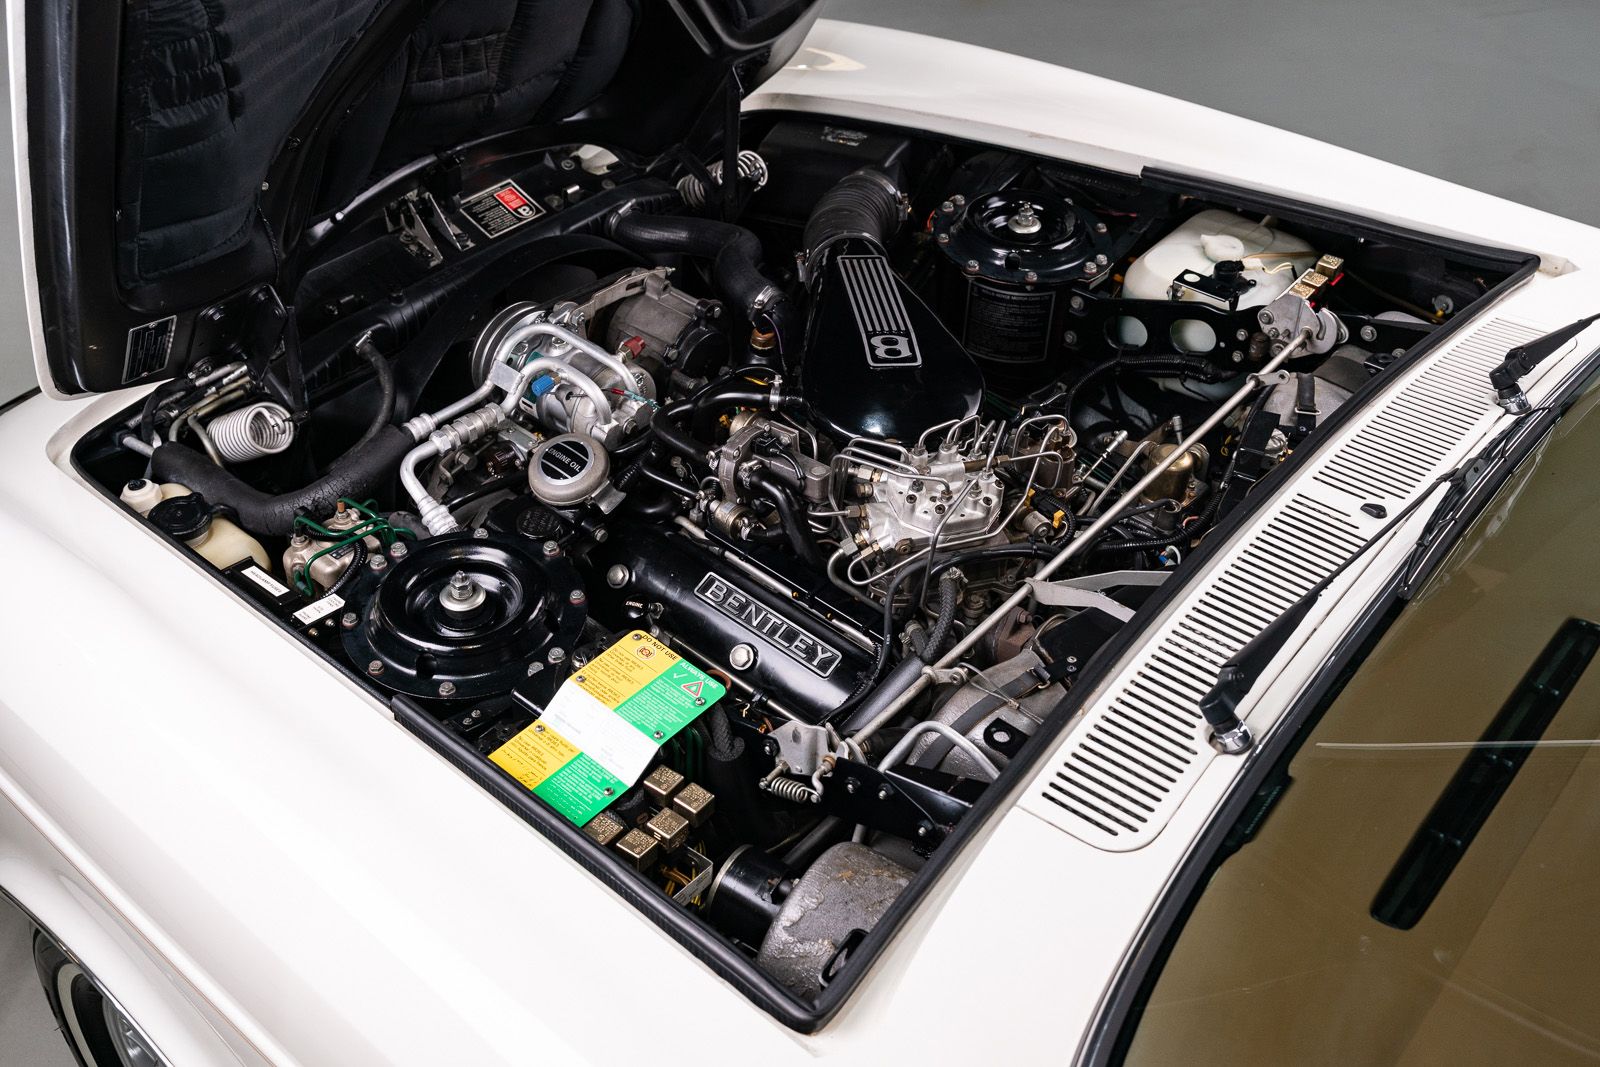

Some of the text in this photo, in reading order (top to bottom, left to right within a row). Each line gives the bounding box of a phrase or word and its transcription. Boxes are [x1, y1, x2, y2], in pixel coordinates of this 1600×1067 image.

[547, 447, 582, 473] ENGINE OIL
[704, 580, 833, 666] BENTLEY
[642, 634, 678, 661] DO NOT USE
[680, 661, 719, 690] ALWAYS USE
